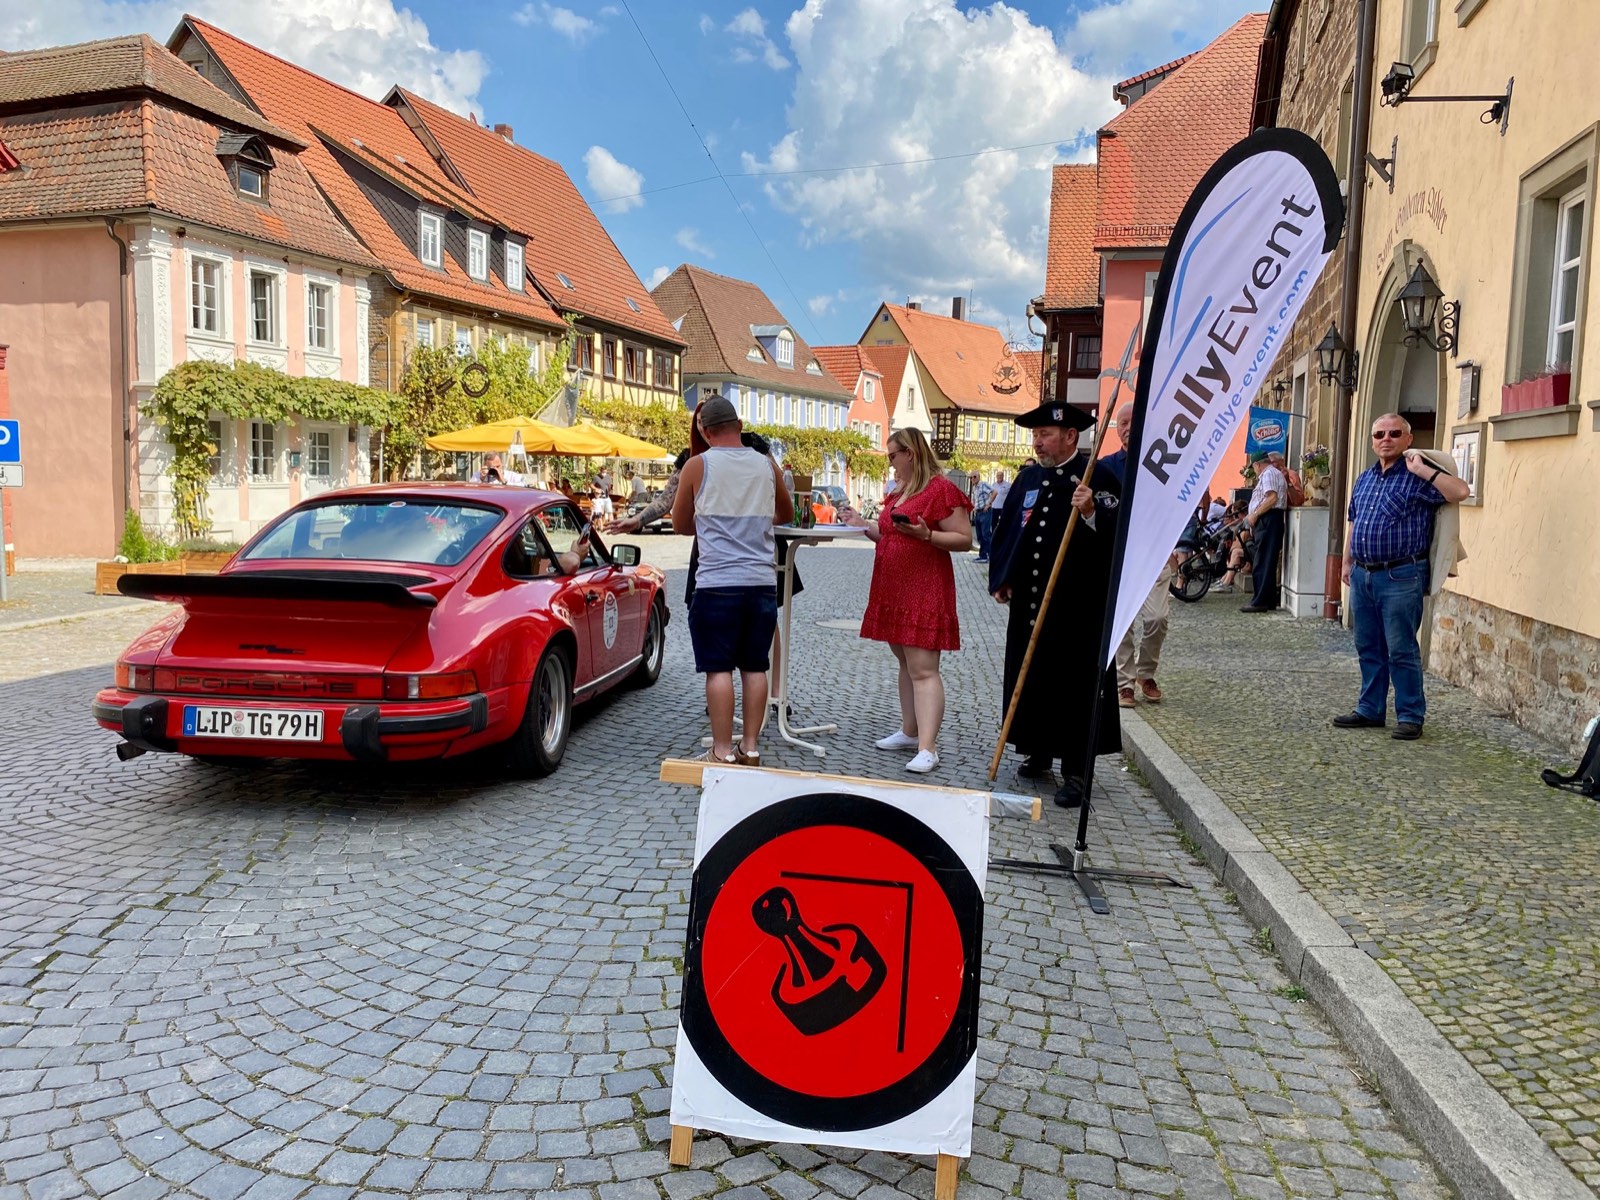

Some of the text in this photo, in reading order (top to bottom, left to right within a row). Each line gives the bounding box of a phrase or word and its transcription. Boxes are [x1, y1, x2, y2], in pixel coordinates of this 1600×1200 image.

[1142, 194, 1316, 485] RallyEvent
[1177, 269, 1308, 503] www.rallye-event.com
[178, 676, 355, 693] PORSCHE
[197, 710, 232, 733] LIP
